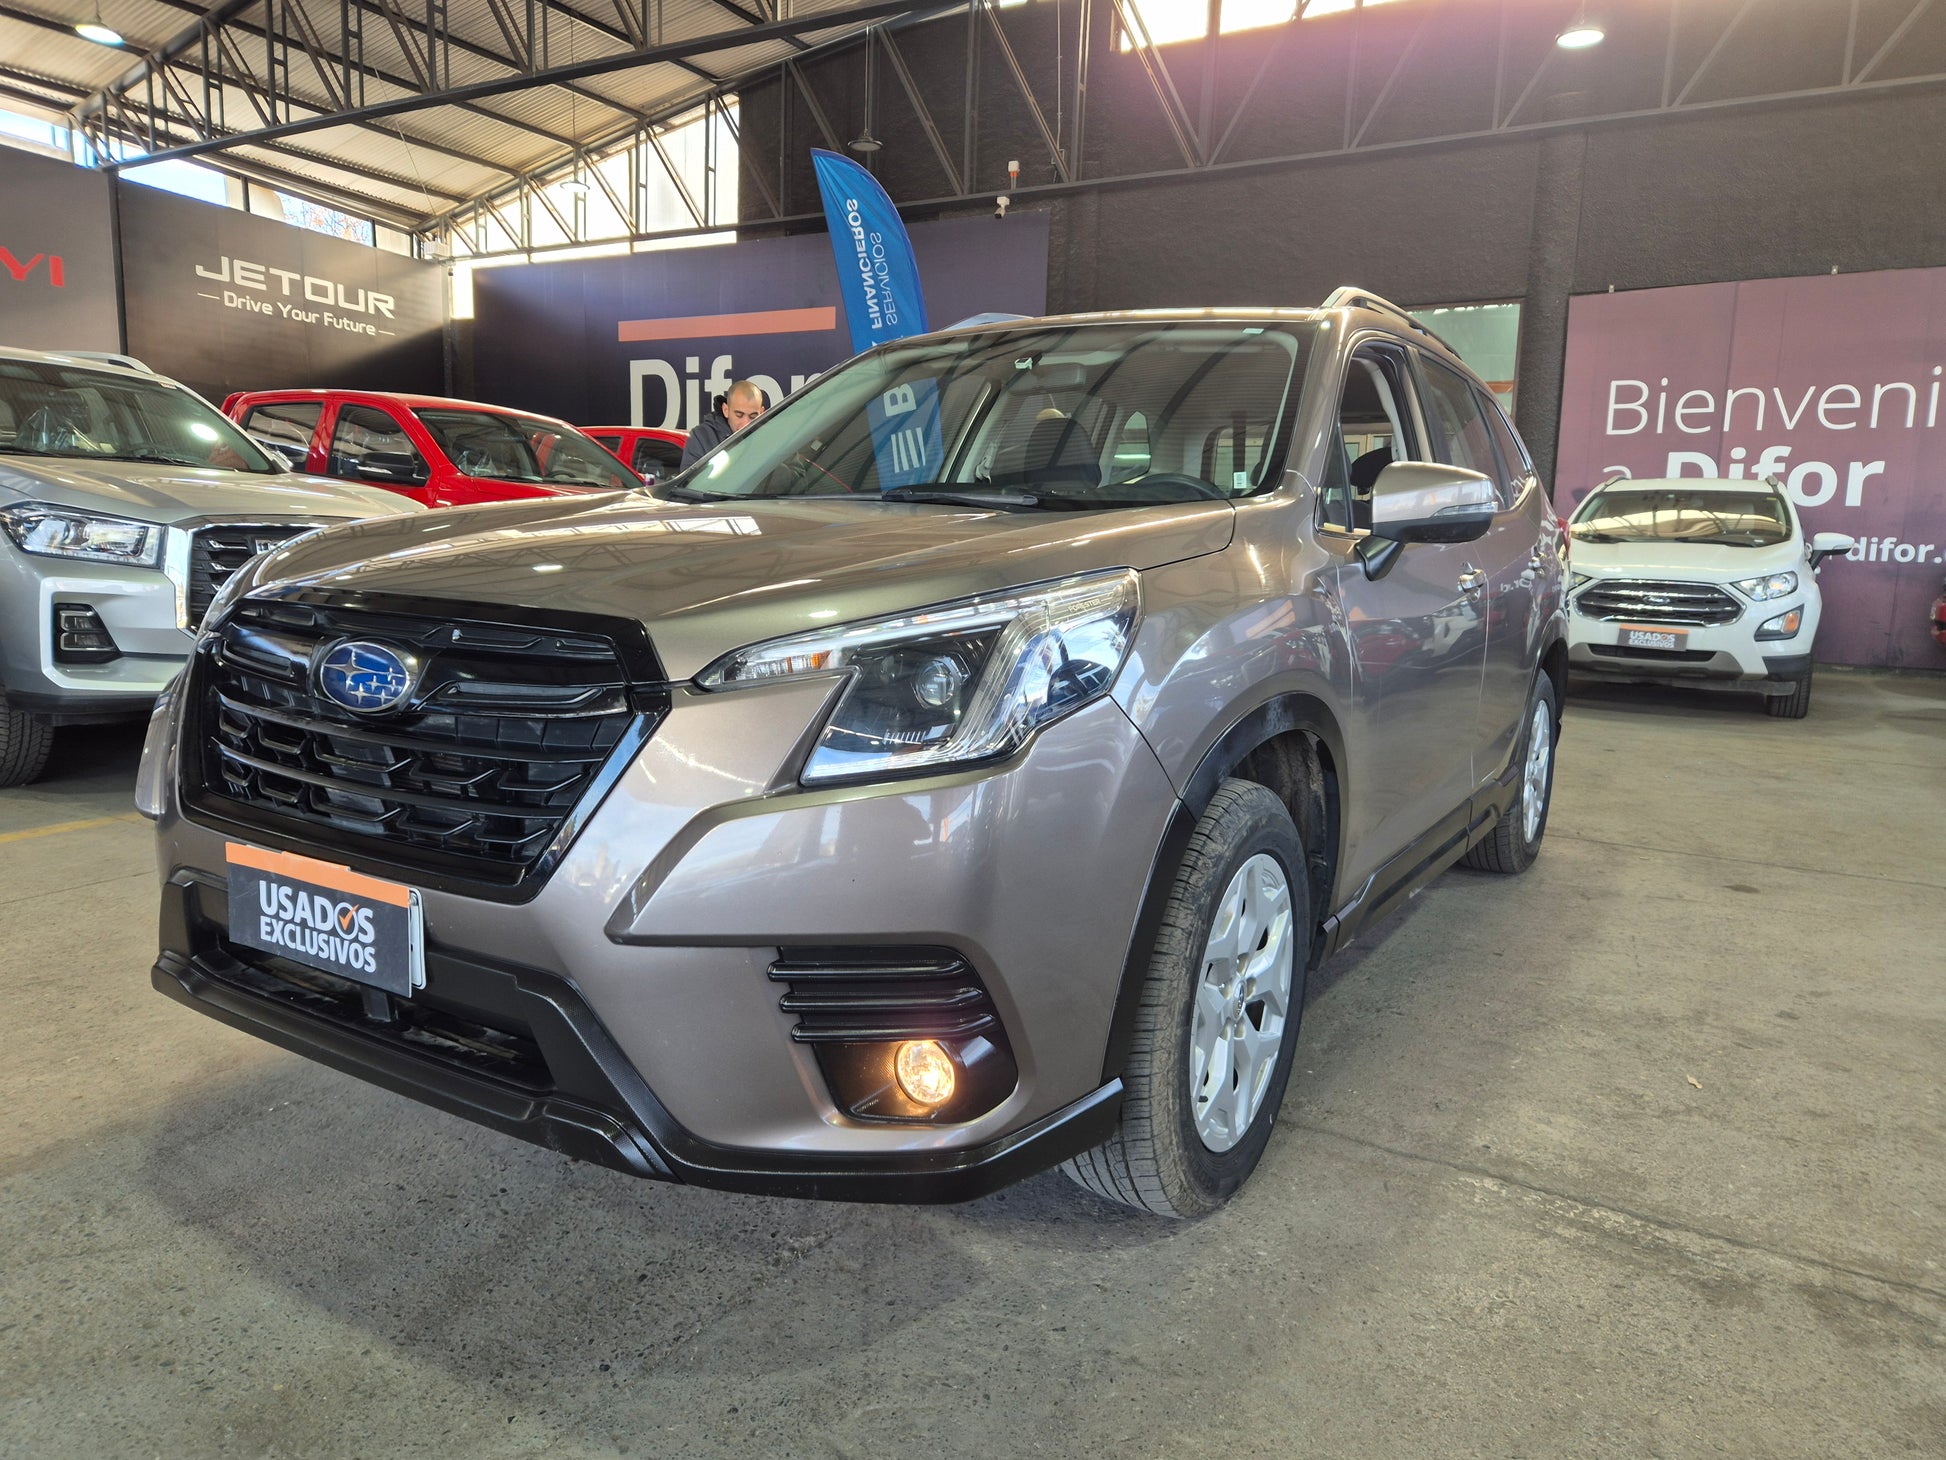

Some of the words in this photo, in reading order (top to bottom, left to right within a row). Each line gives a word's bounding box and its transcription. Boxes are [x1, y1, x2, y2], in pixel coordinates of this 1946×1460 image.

[195, 256, 395, 320] JETOUR
[223, 290, 273, 316] Drive
[277, 302, 320, 325] Your
[323, 312, 376, 336] Future
[1606, 365, 1943, 435] Bienveni
[1845, 536, 1946, 564] difor.
[1628, 638, 1675, 649] EXCLUSIVOS
[1629, 630, 1676, 642] USADOS
[259, 880, 375, 944] USADOS
[260, 915, 377, 973] EXCLUSIVOS
